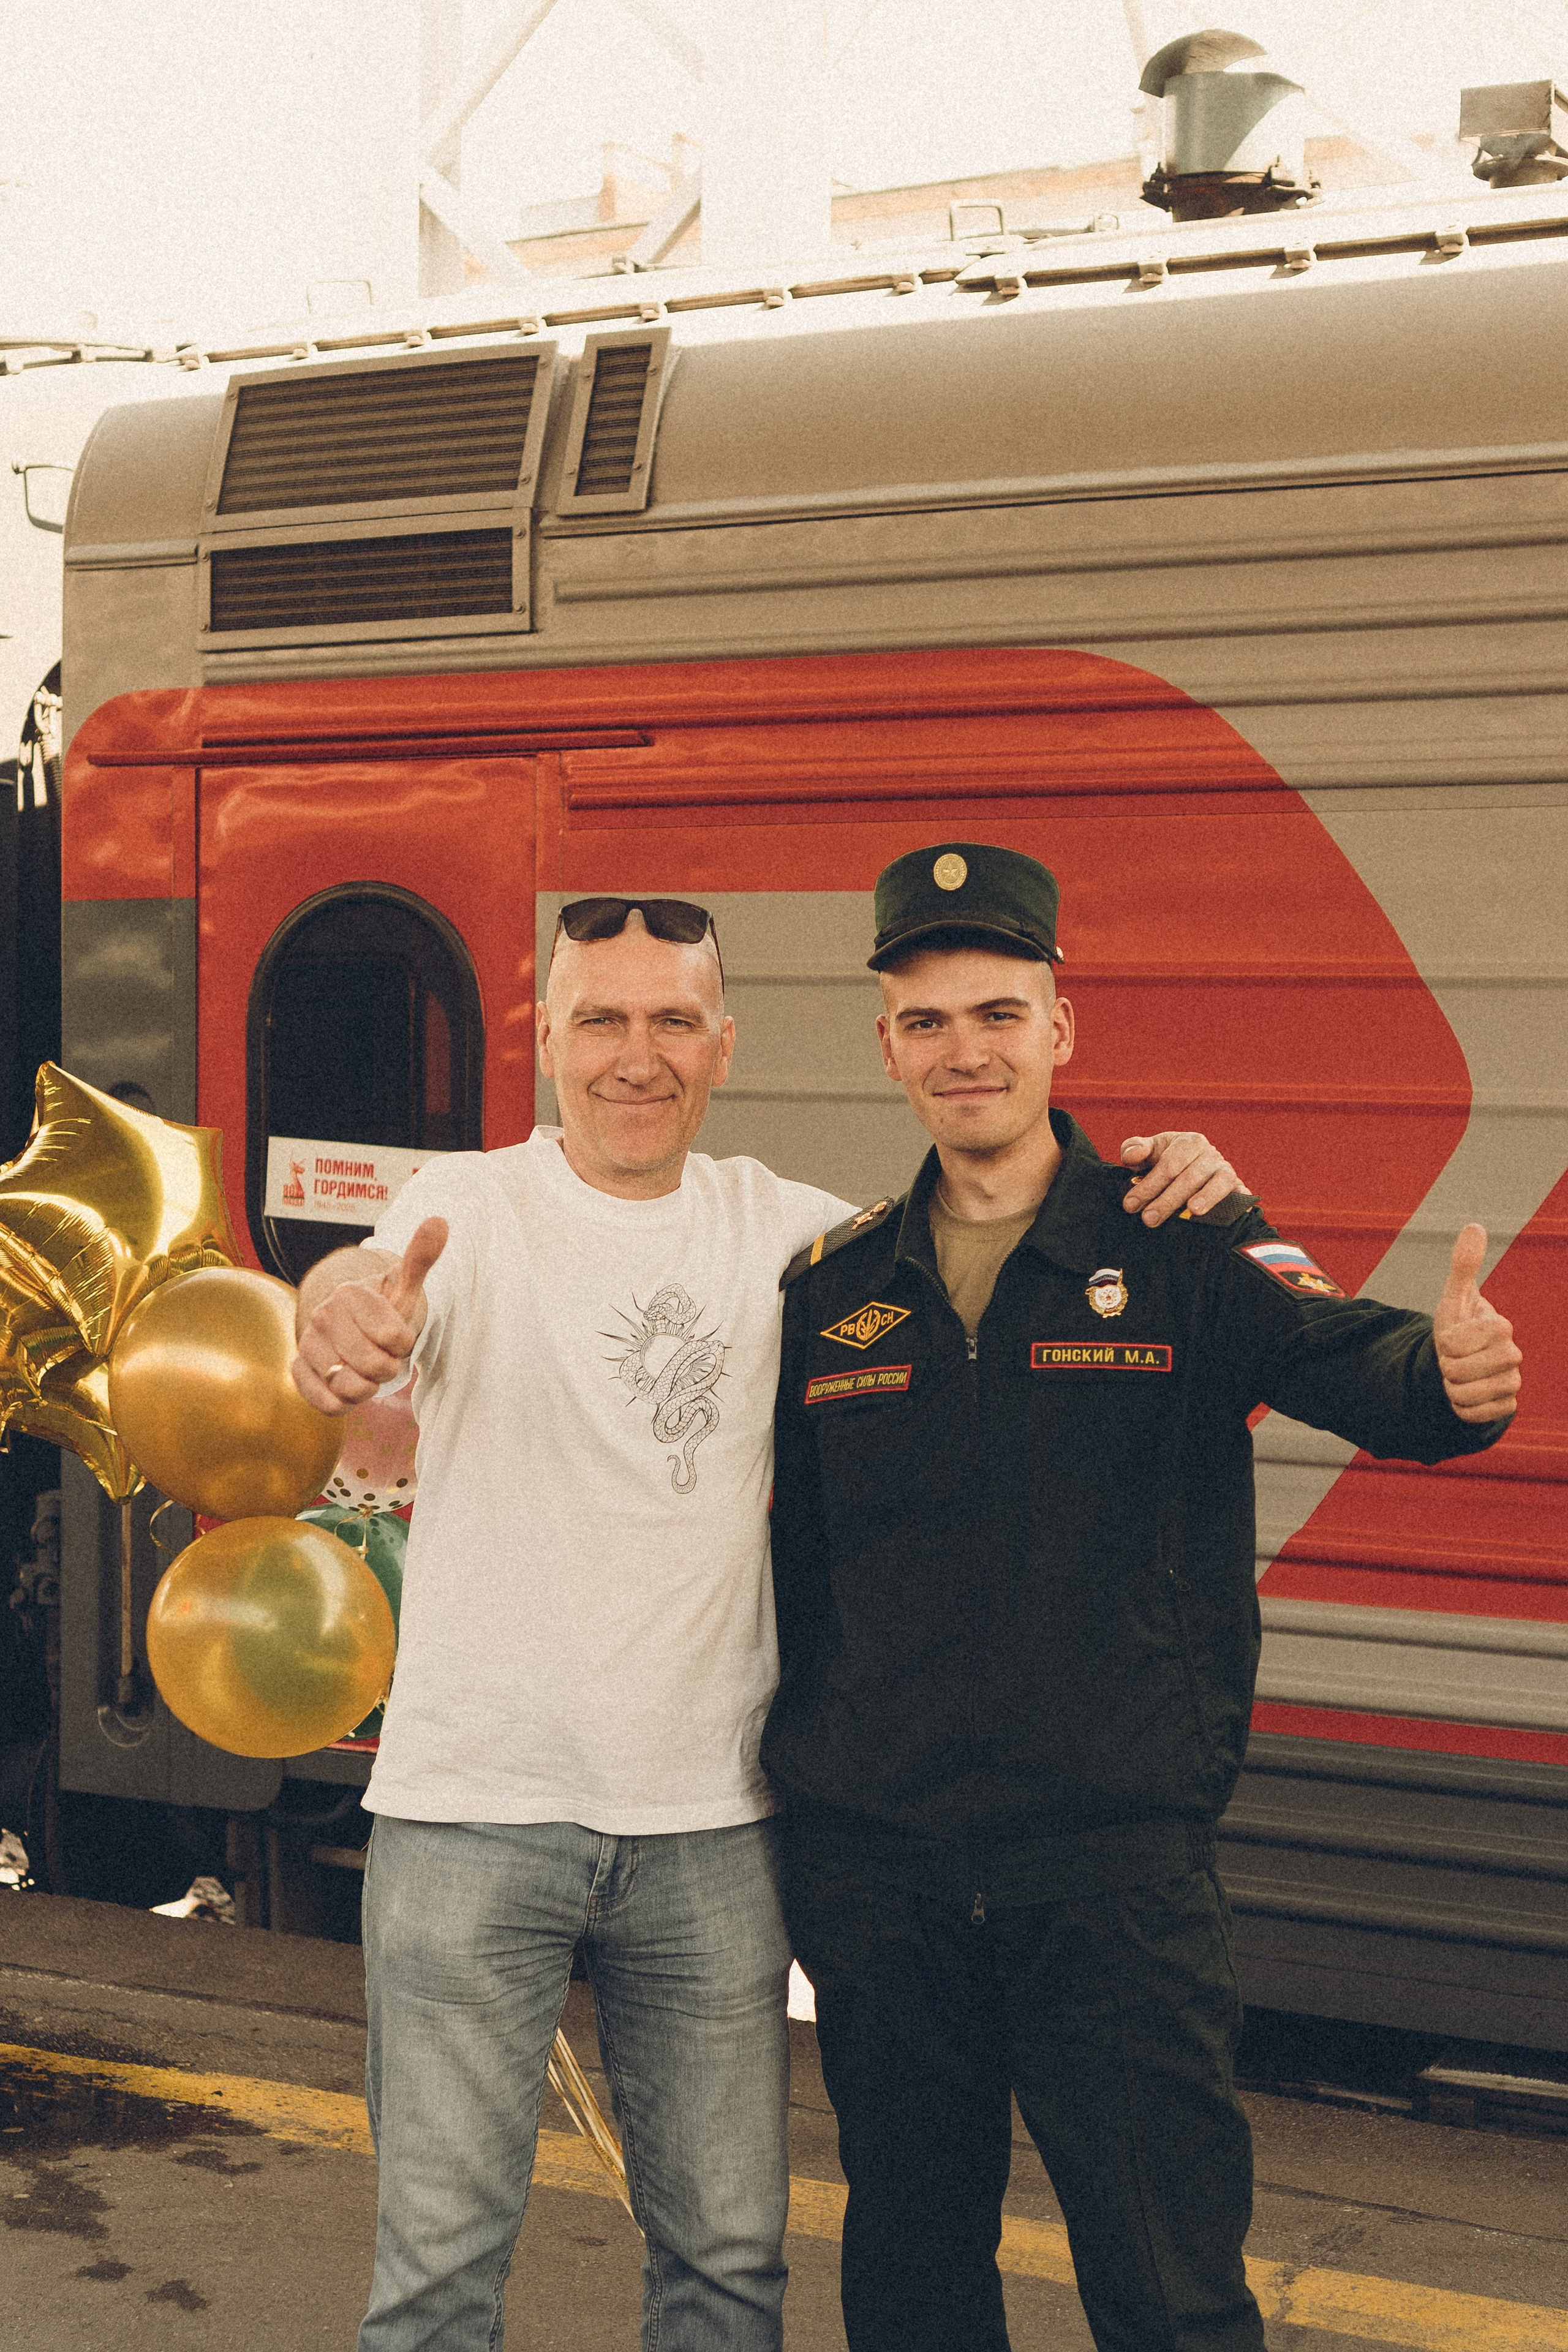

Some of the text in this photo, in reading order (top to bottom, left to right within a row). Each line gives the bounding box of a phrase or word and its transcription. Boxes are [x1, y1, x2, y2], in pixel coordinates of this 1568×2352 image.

[314, 1158, 378, 1182] ПОМНИМ,
[313, 1178, 388, 1201] ГОРДИМСЯ!
[840, 1311, 894, 1336] РВ СН
[1042, 1348, 1160, 1364] ГОНСКИЙ М.А.
[809, 1371, 908, 1398] ВООРУЖЕННЫЕ СИЛЫ РОССИИ
